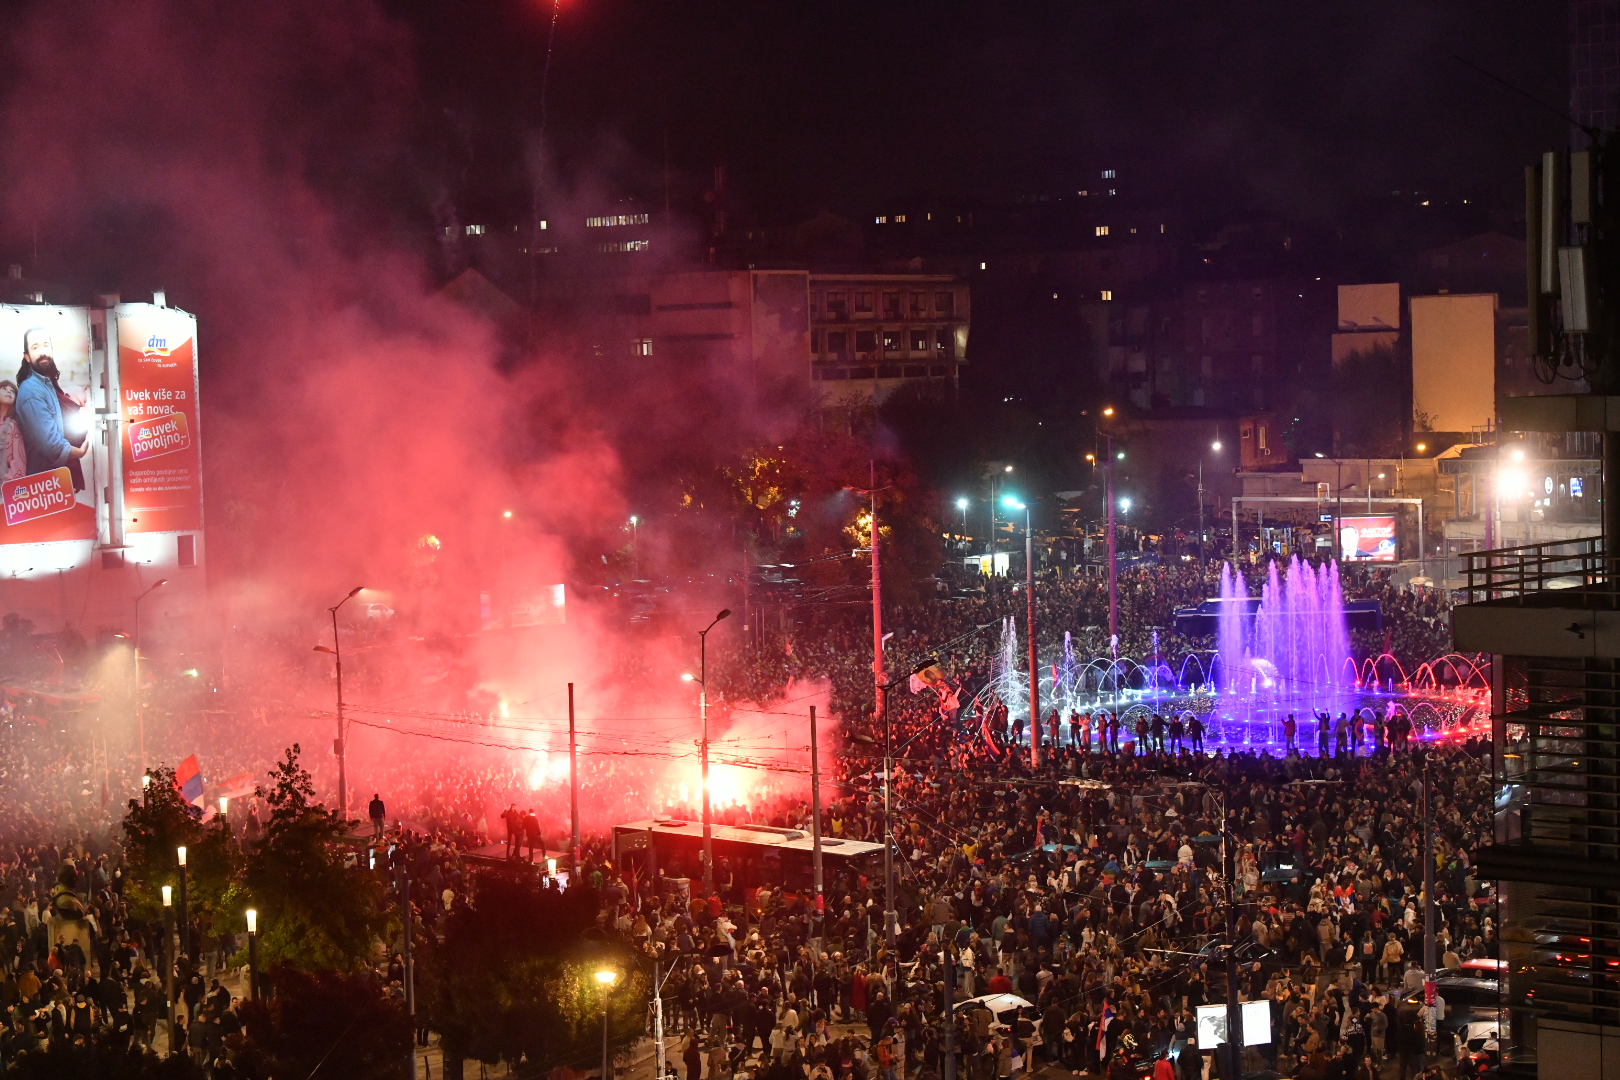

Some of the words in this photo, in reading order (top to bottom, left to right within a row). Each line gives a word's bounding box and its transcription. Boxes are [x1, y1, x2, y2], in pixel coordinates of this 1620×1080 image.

[148, 334, 166, 348] dm
[125, 388, 151, 401] Uvek
[152, 388, 173, 400] više
[175, 390, 187, 400] za
[127, 403, 144, 416] vaš
[151, 420, 179, 437] uvek
[29, 476, 62, 496] uvek
